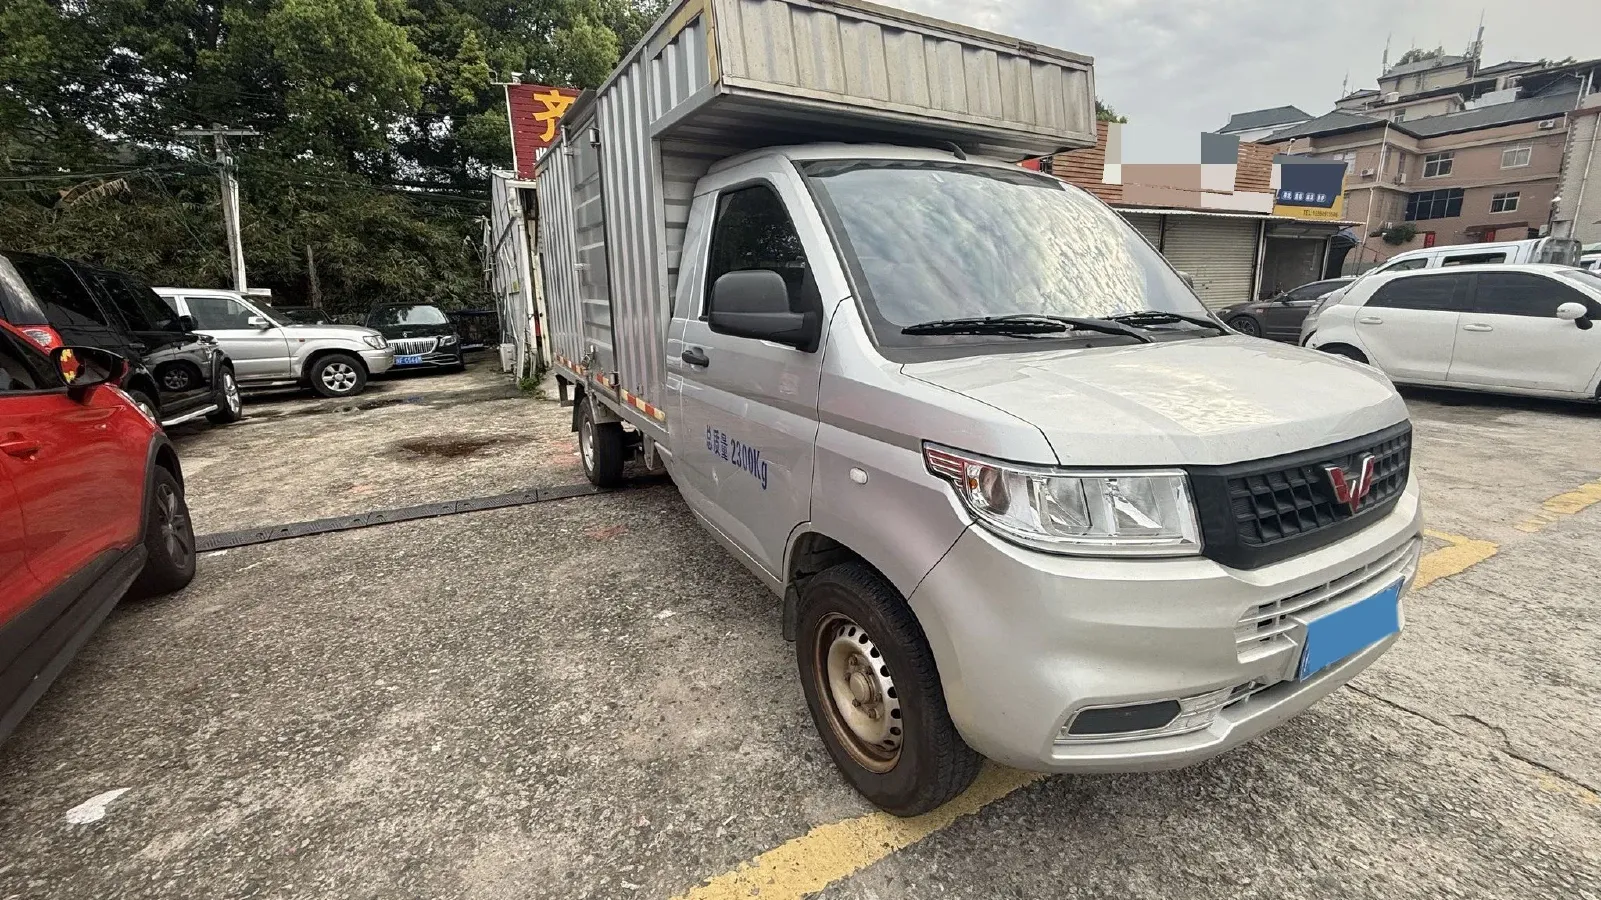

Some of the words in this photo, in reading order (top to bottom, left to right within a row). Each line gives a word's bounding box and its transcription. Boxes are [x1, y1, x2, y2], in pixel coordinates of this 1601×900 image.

[706, 424, 729, 461] 总质量
[730, 438, 768, 491] 2300Kg
